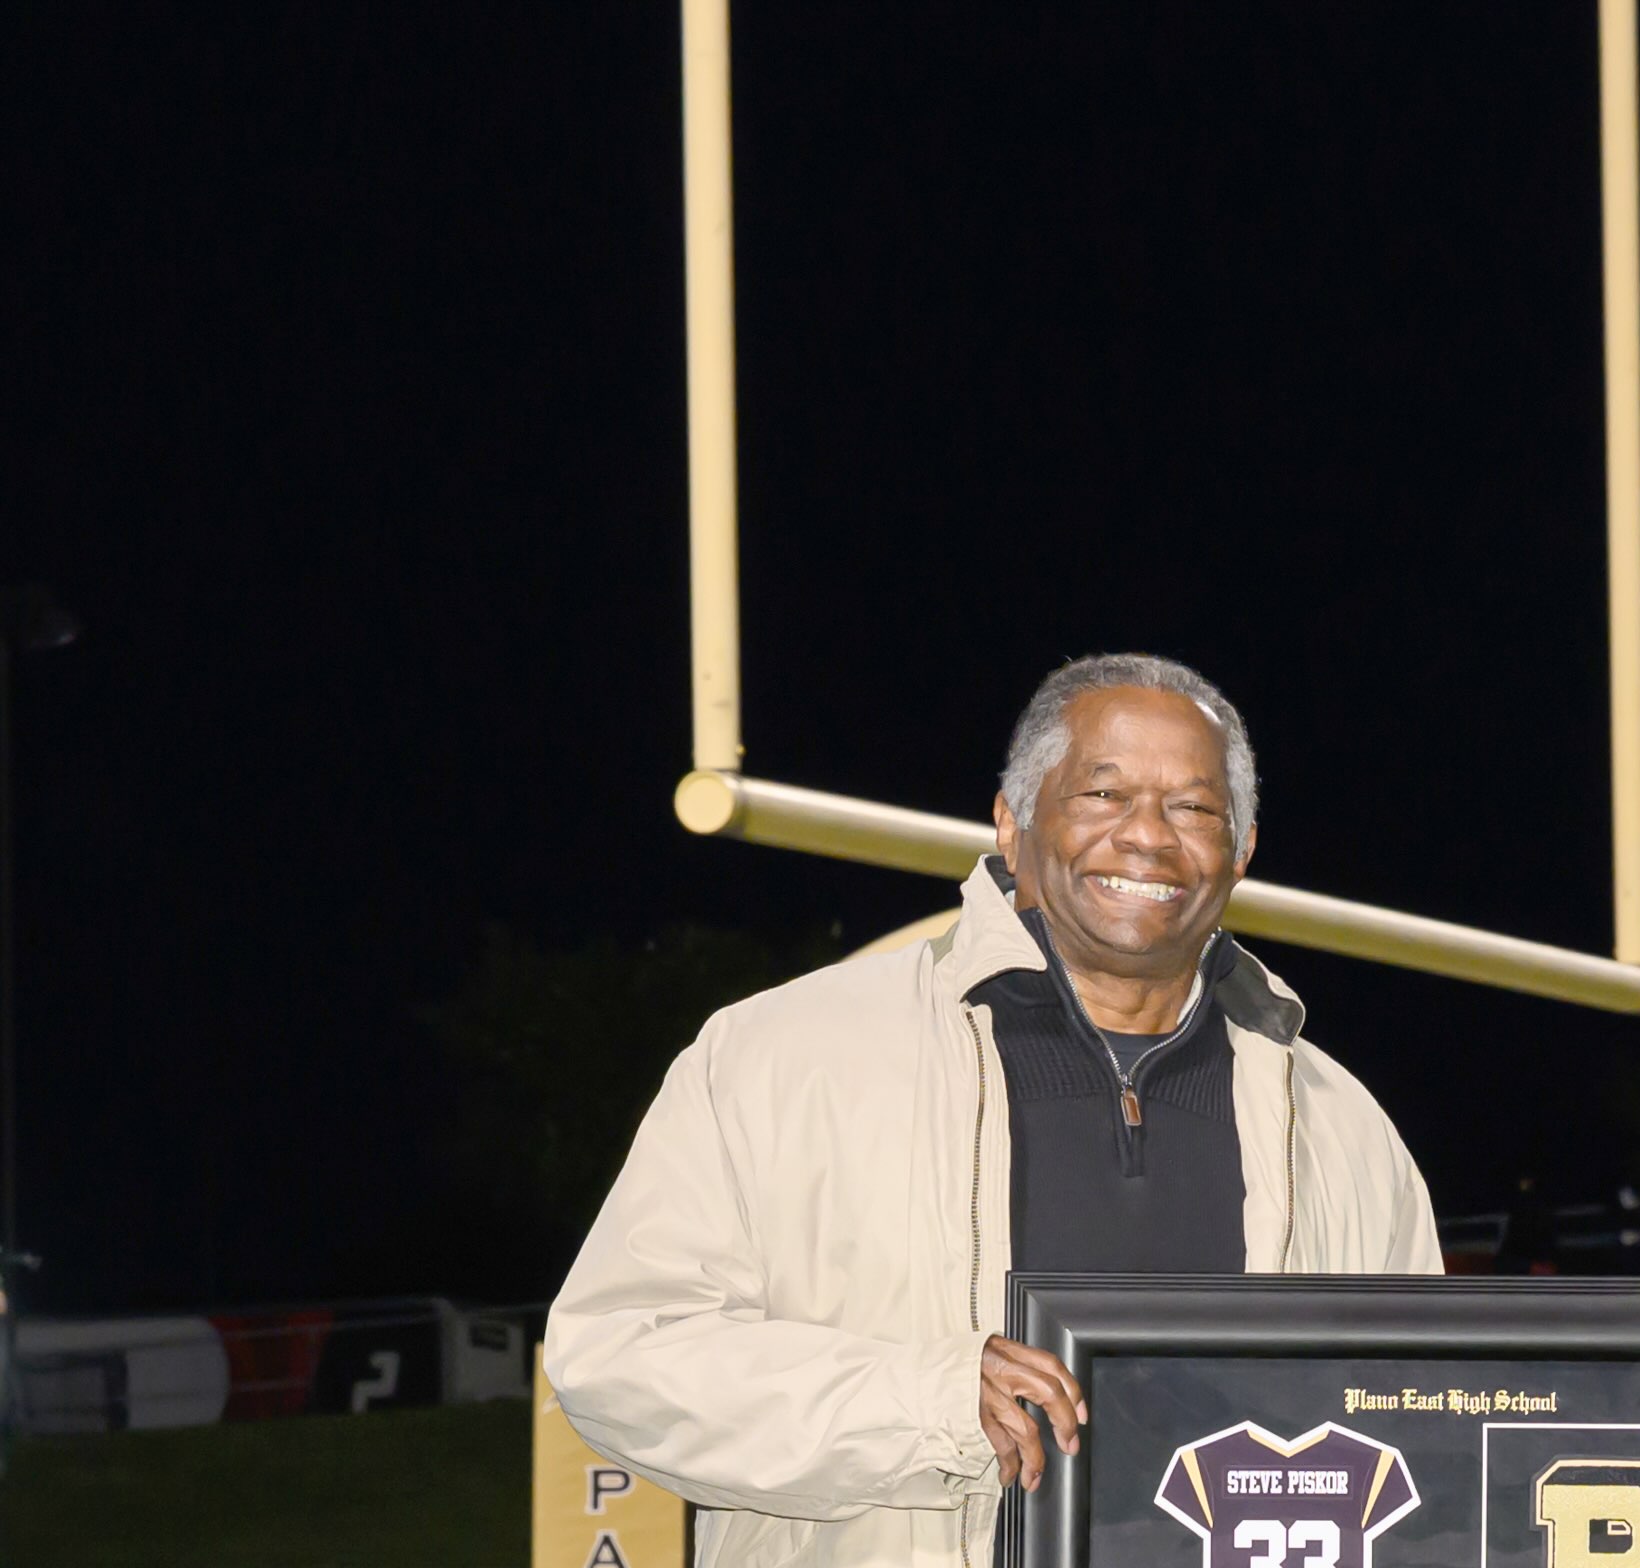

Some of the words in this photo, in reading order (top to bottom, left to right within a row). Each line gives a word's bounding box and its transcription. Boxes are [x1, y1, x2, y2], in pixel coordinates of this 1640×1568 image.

[1344, 1388, 1399, 1415] Plano
[1402, 1388, 1445, 1412] East
[1447, 1388, 1491, 1415] High
[1493, 1389, 1558, 1415] School
[1227, 1470, 1283, 1494] STEVE
[1287, 1470, 1349, 1495] PISKOR
